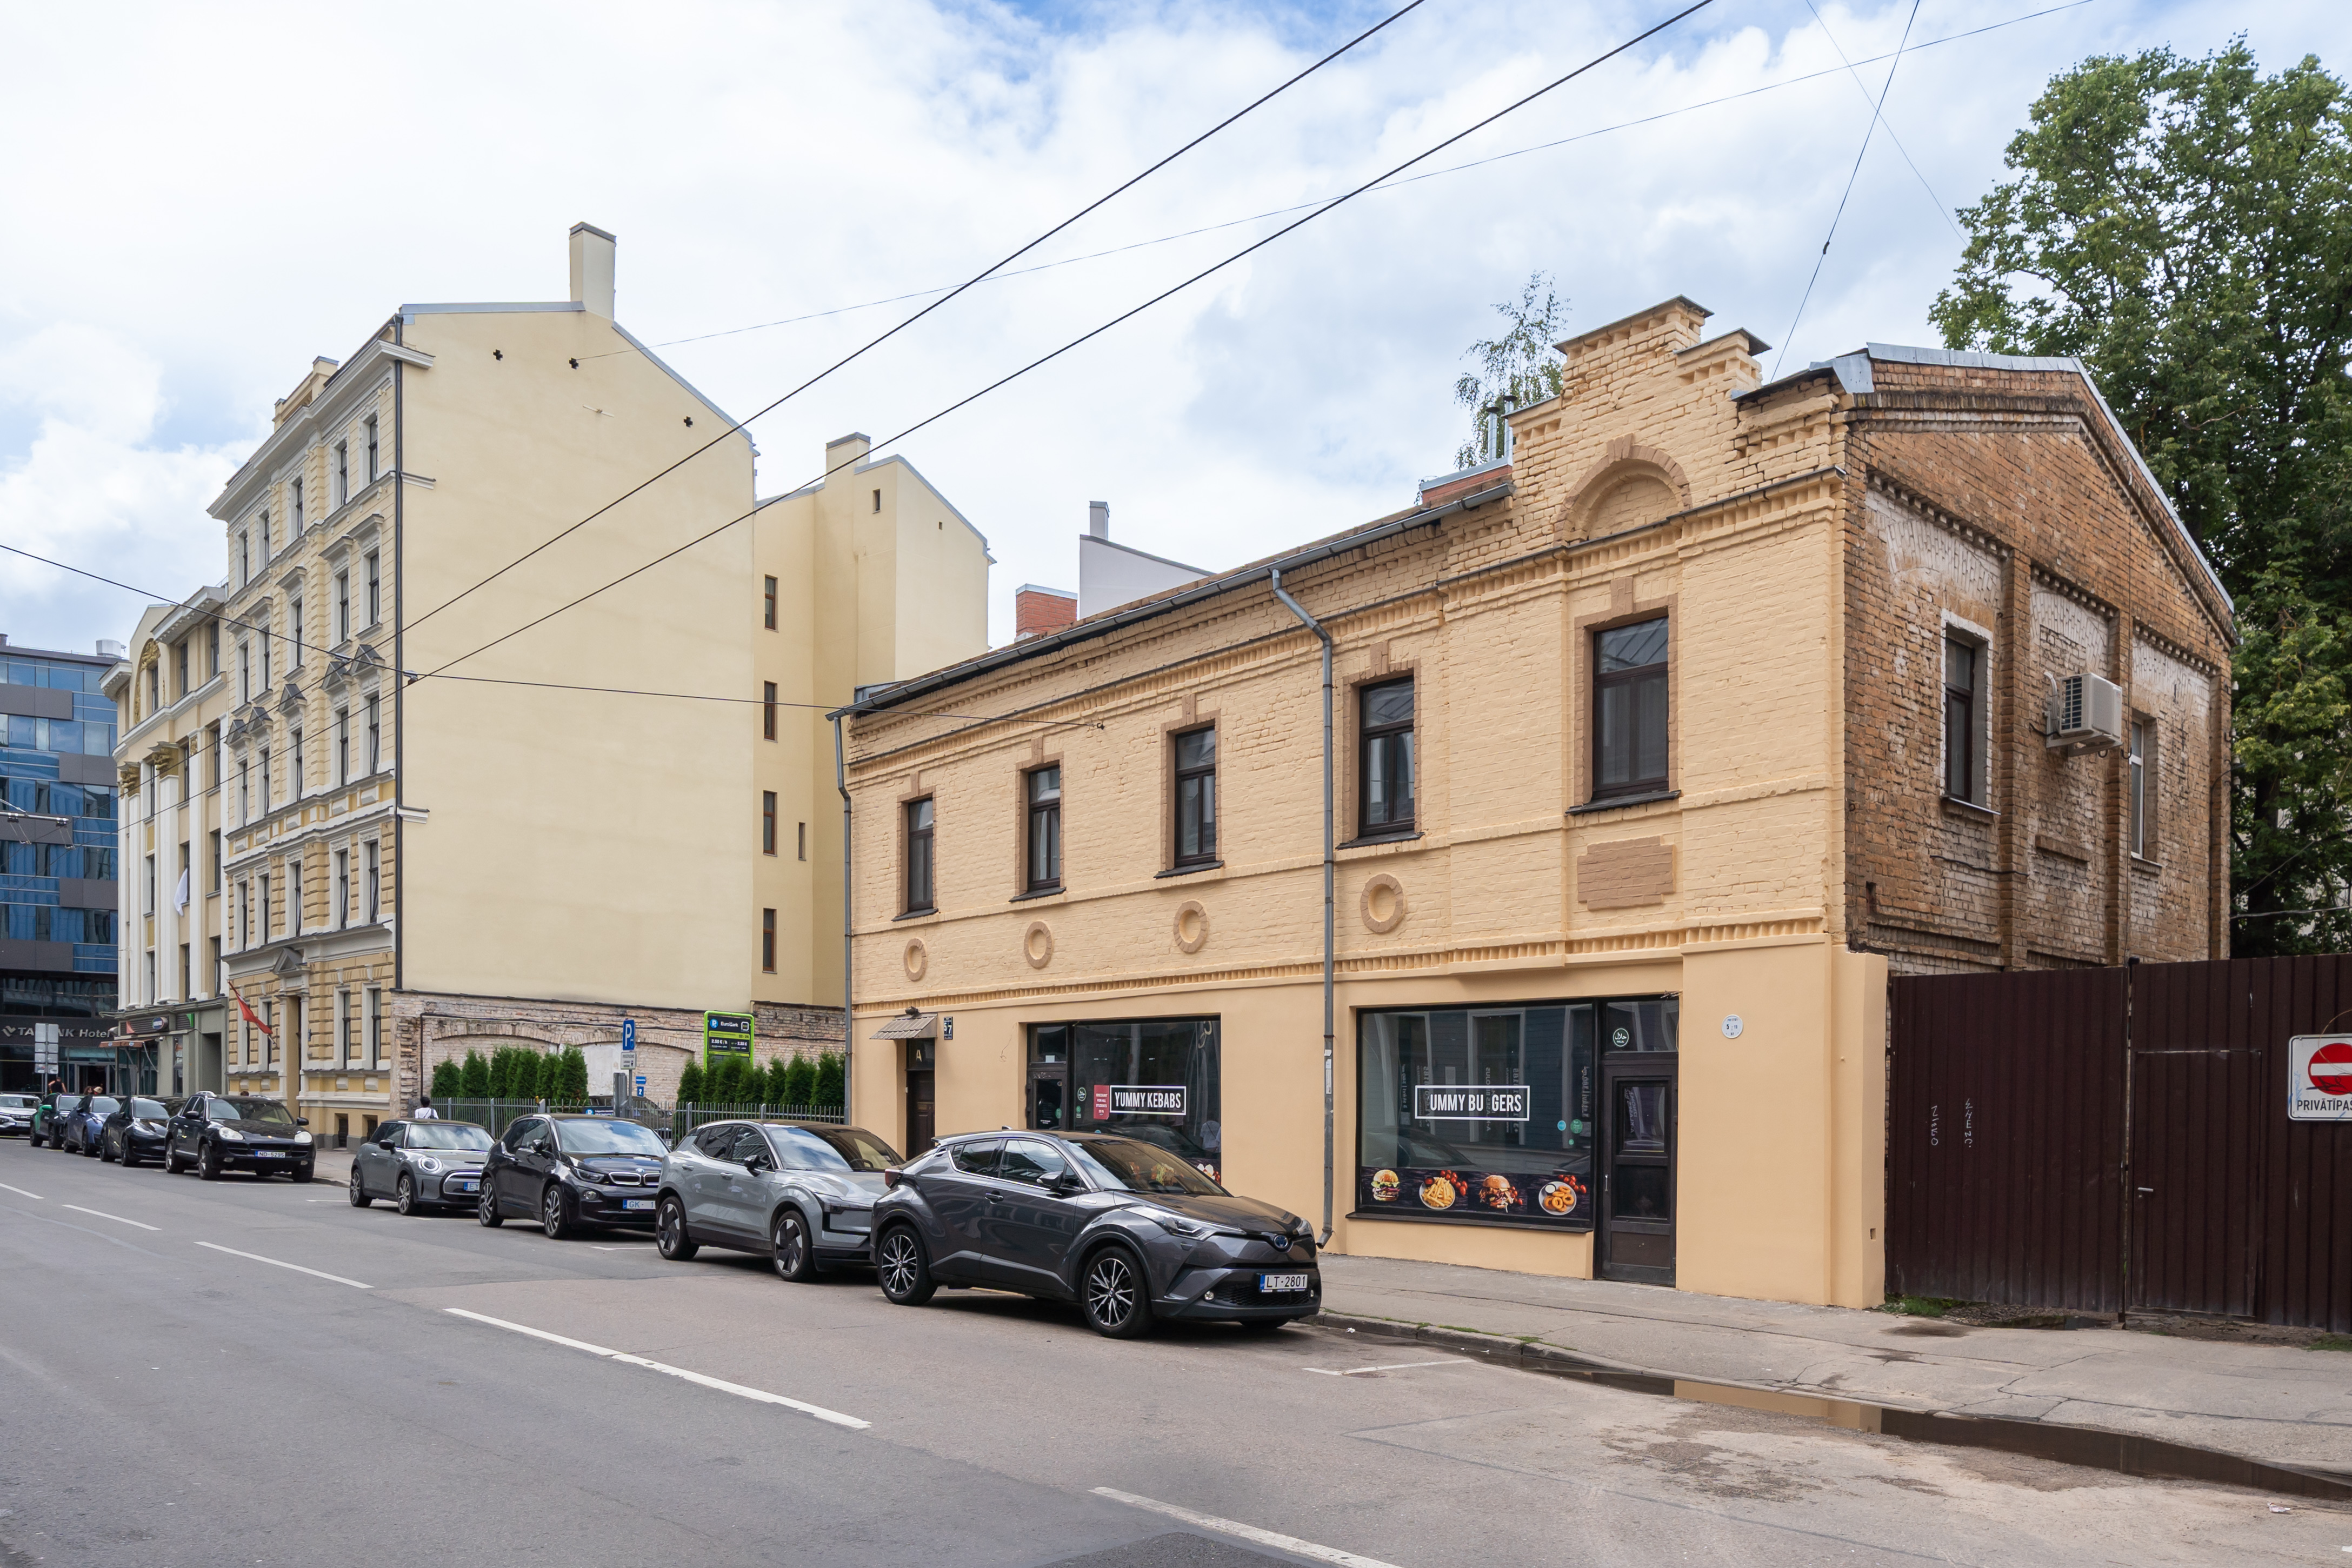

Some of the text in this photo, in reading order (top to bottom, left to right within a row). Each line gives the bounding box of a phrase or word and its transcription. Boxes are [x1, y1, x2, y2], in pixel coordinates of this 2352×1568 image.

[18, 1027, 110, 1038] TANK Hotel
[625, 1024, 632, 1047] P
[916, 1050, 922, 1062] A
[1115, 1092, 1181, 1108] YUMMY KEBABS
[2297, 1098, 2352, 1111] PRIVĀTĪPA
[1267, 1276, 1305, 1287] LT-2801
